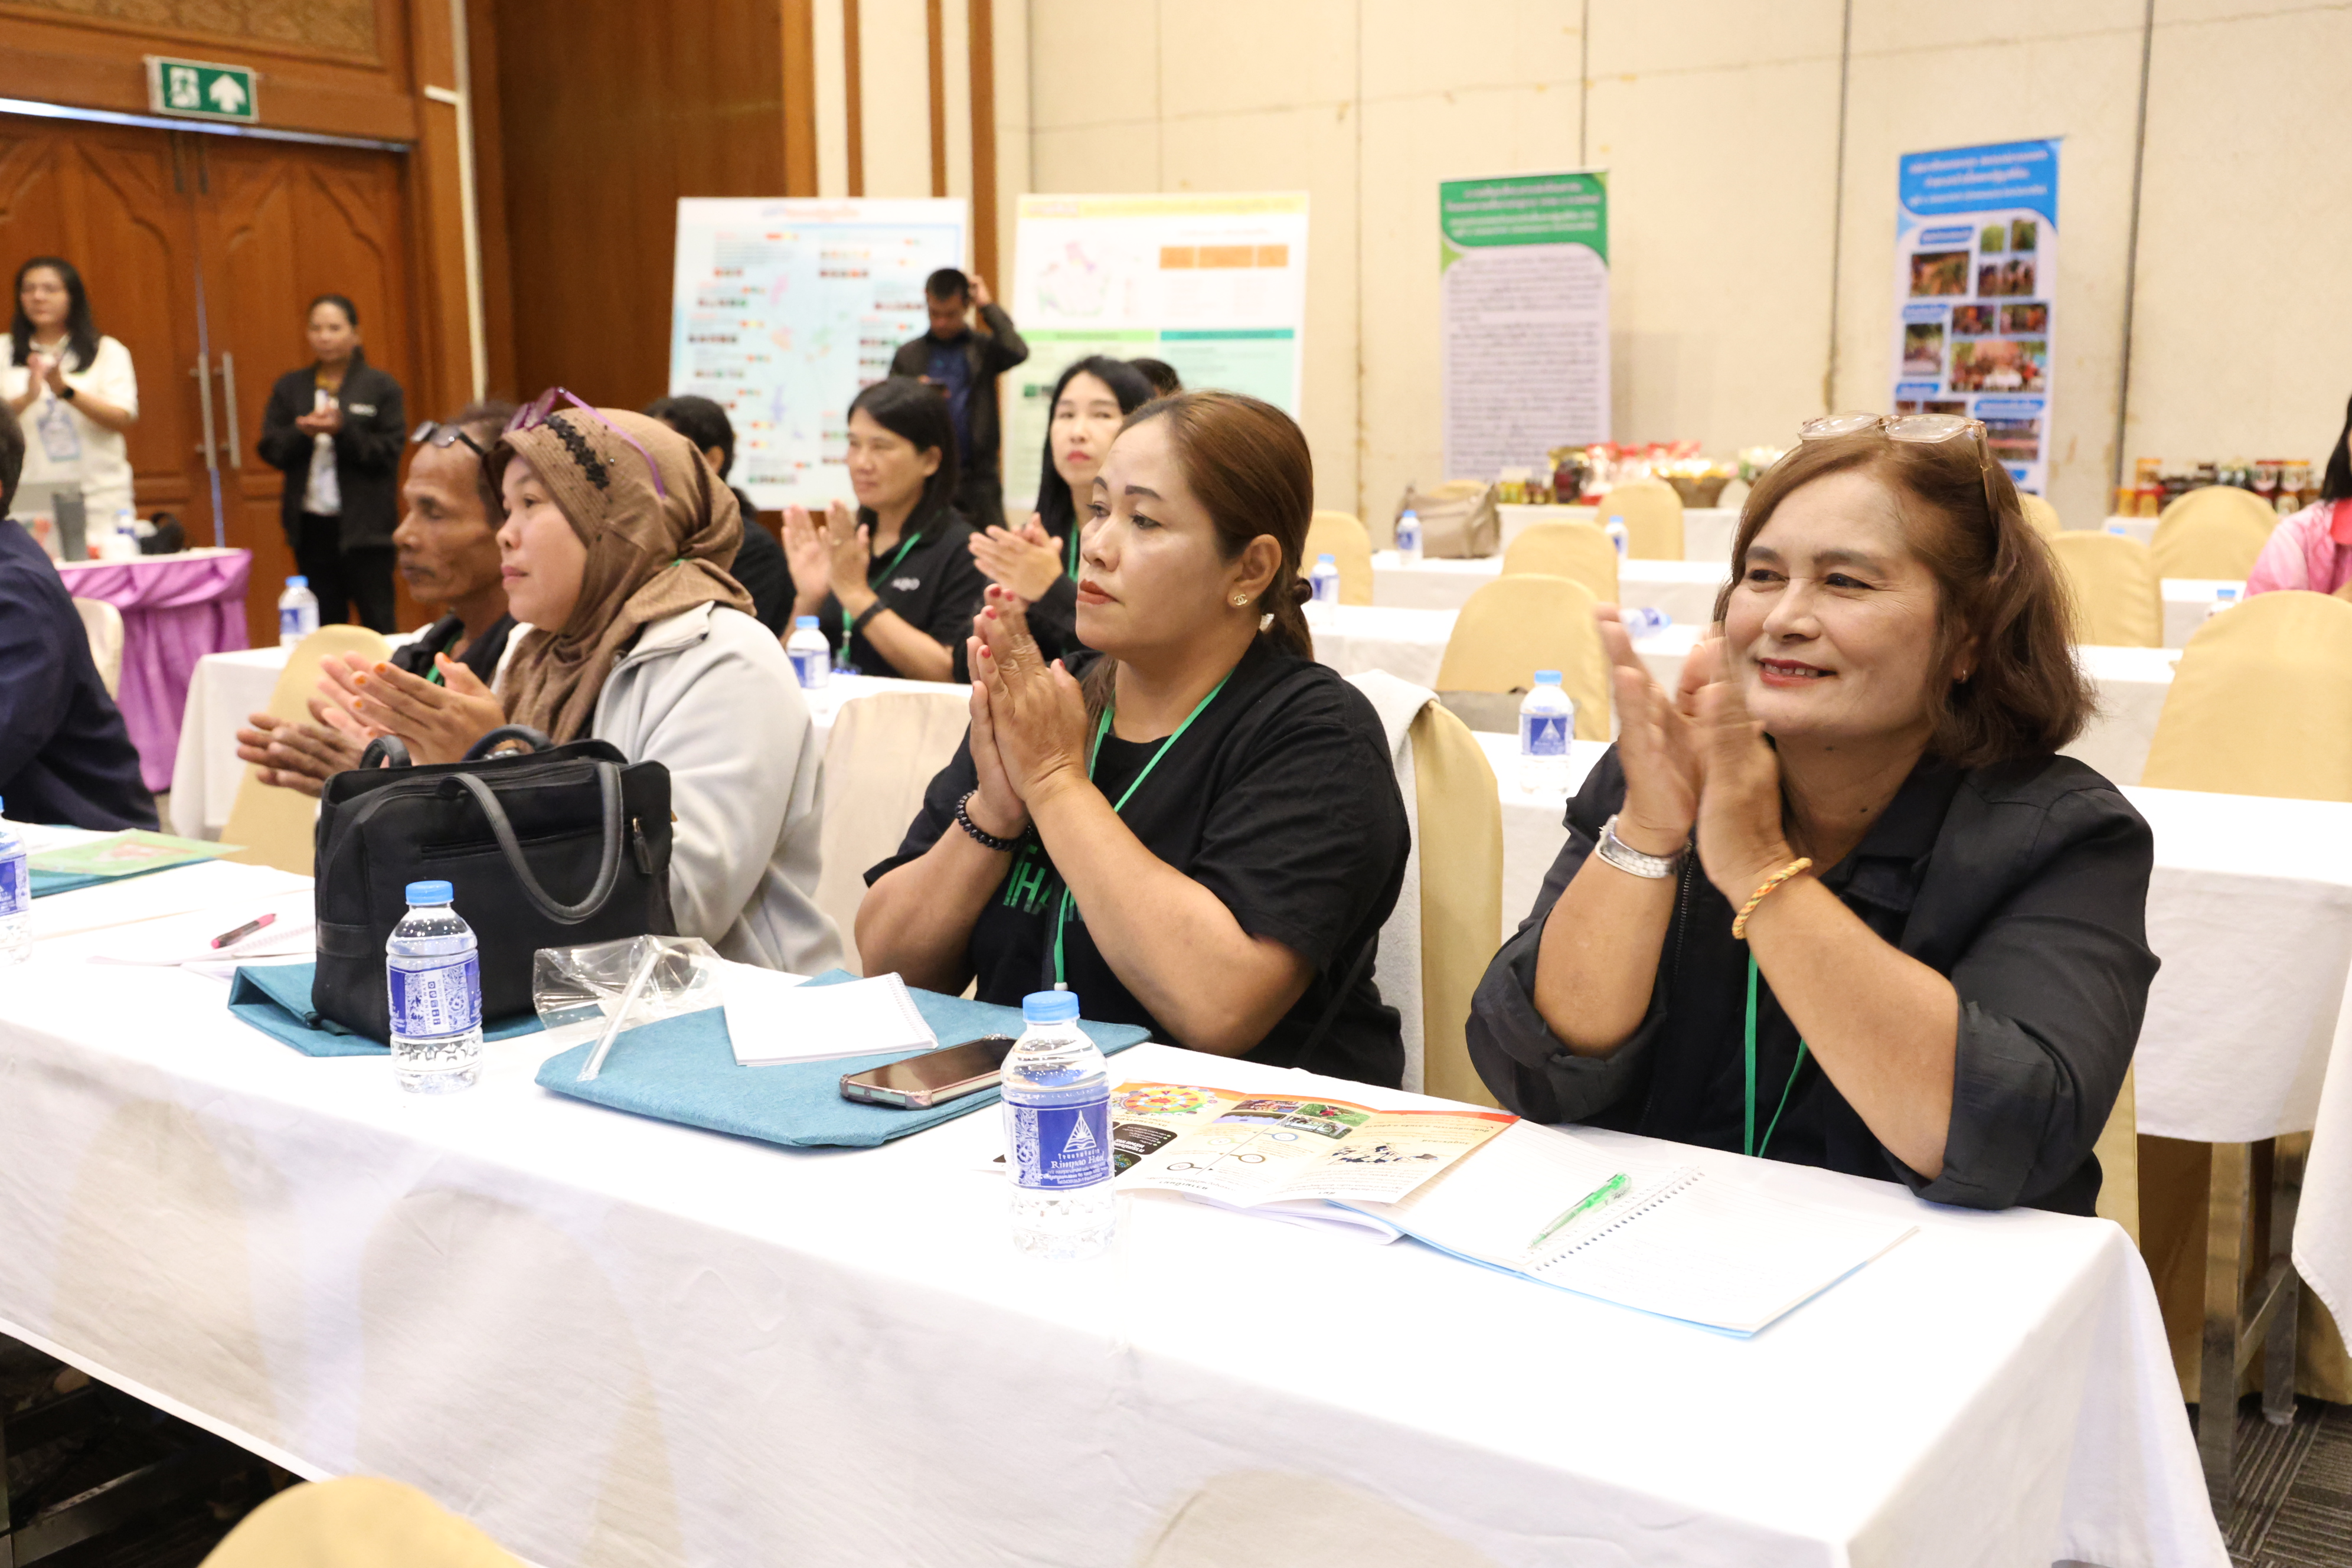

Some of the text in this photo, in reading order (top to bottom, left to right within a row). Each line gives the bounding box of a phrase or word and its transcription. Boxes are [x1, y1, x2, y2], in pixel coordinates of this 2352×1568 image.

[423, 999, 433, 1033] DRINKING
[1051, 1159, 1087, 1170] Rimpao
[1088, 1151, 1105, 1164] Hotel
[1158, 1181, 1208, 1190] ความเป็นมา
